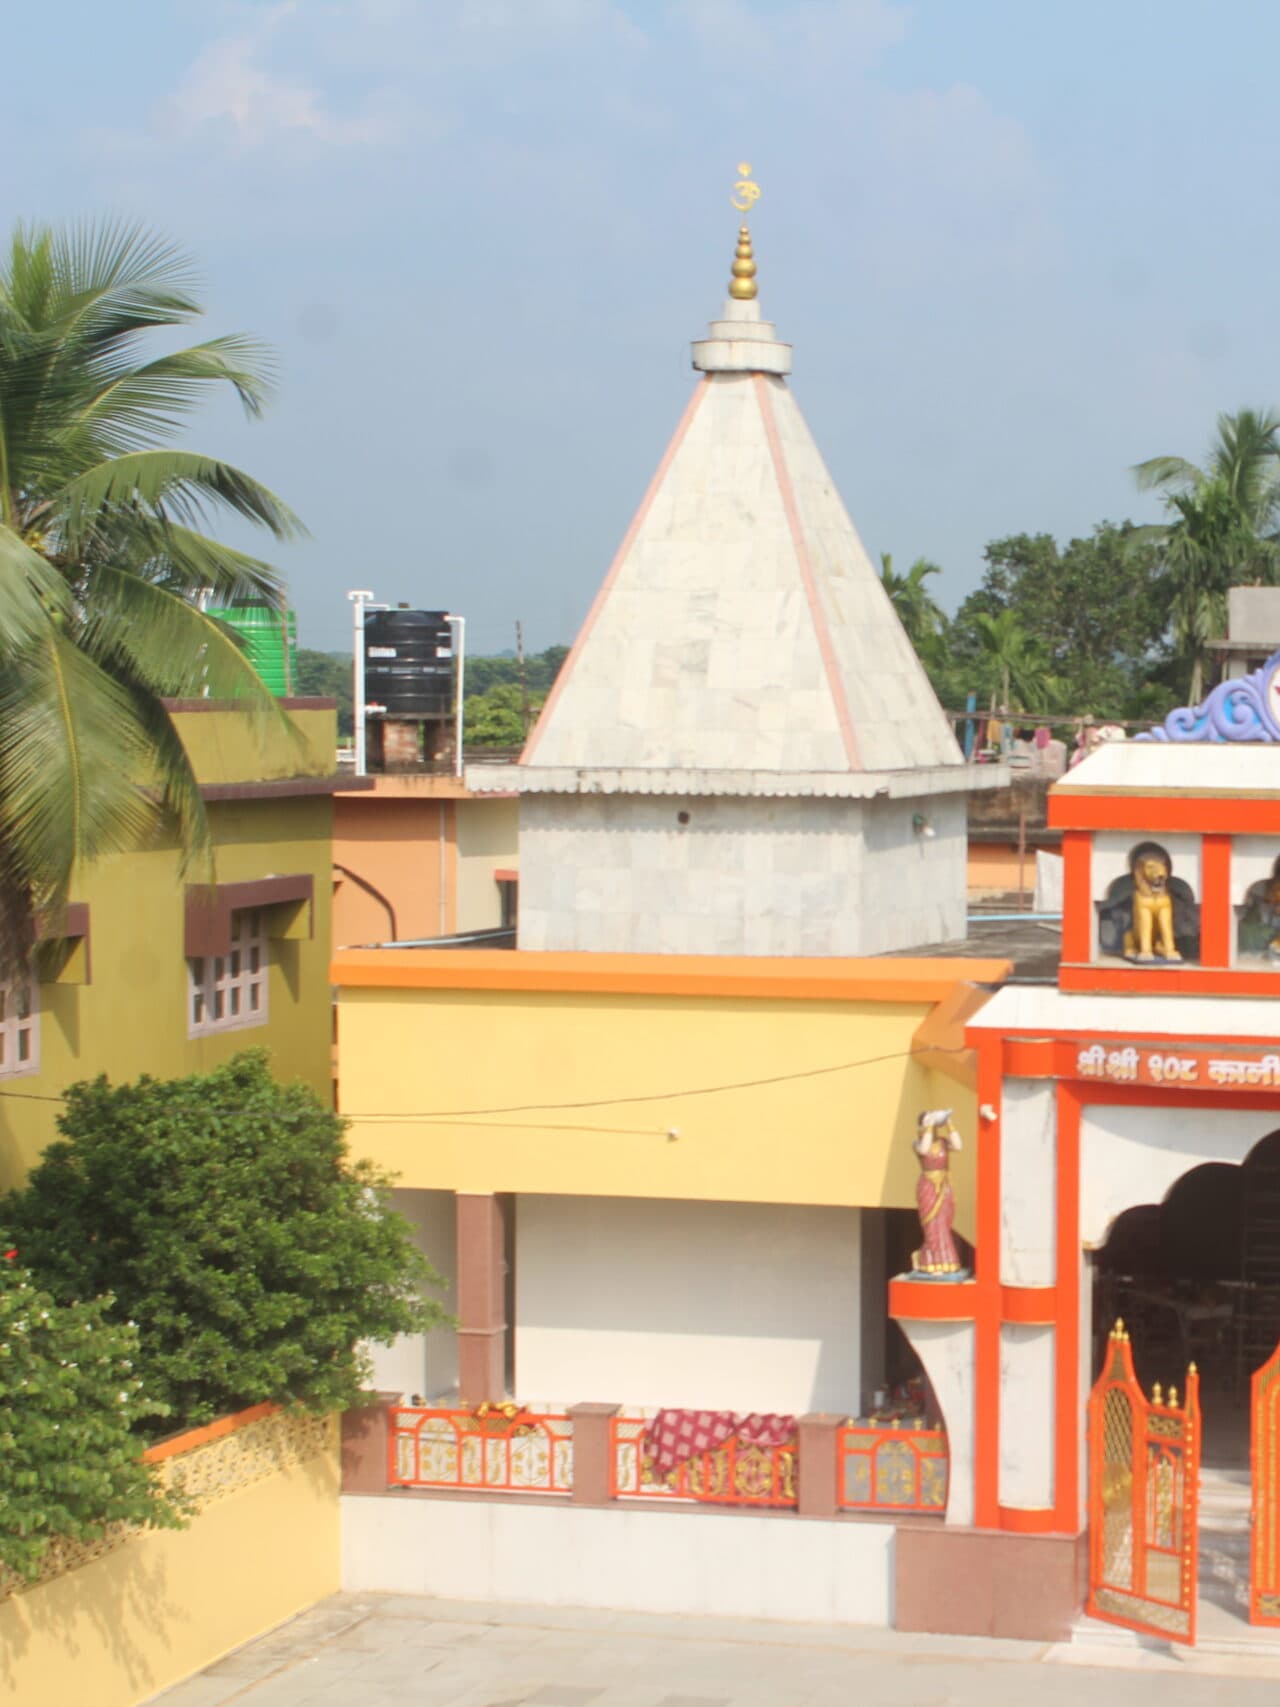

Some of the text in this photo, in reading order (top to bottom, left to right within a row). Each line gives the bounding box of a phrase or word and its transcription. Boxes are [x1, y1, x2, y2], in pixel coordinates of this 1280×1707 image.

[1077, 1045, 1106, 1076] श्री
[1106, 1048, 1139, 1080] श्री
[1148, 1054, 1198, 1083] १०८
